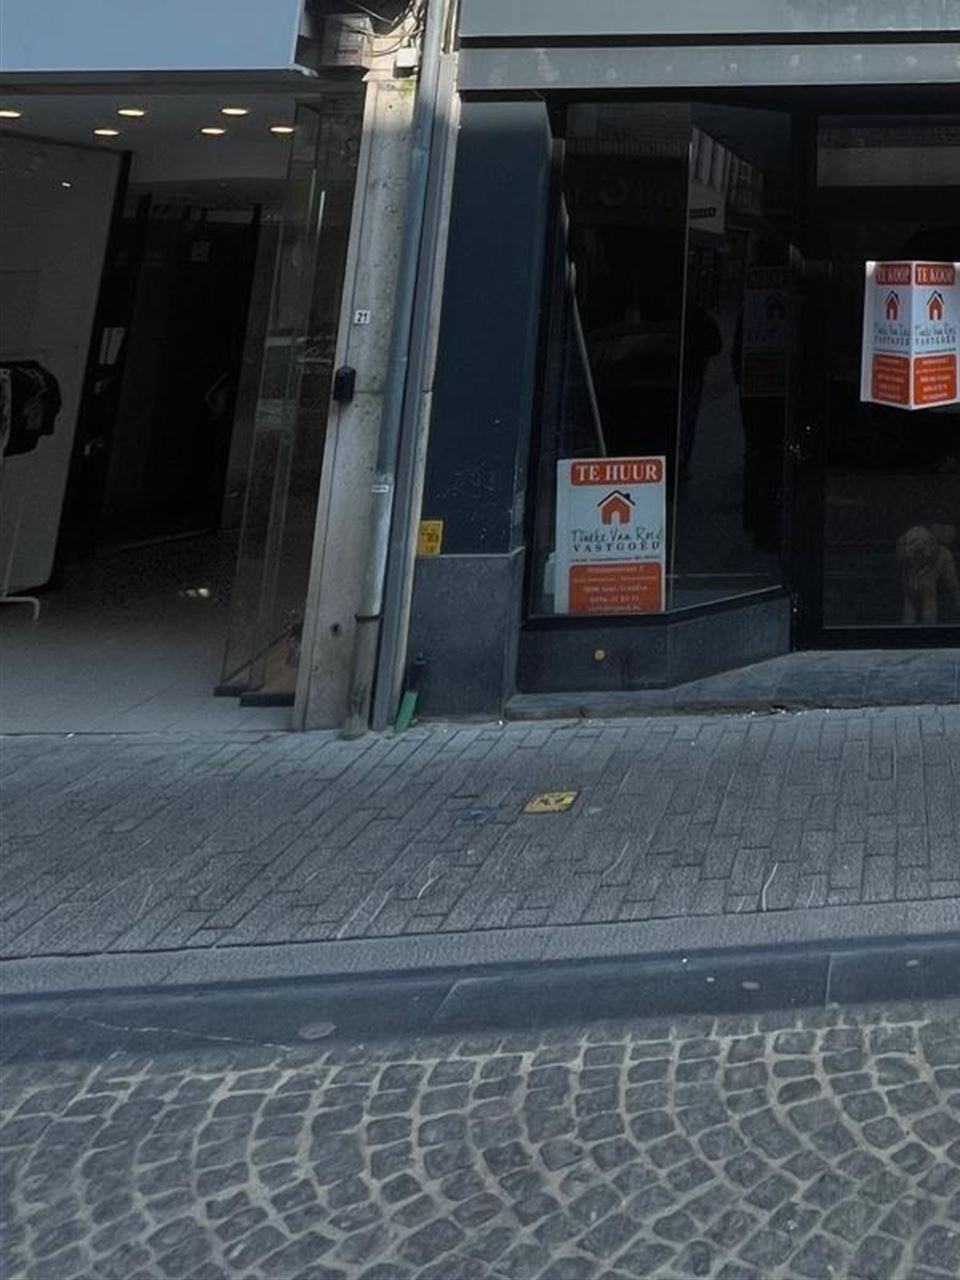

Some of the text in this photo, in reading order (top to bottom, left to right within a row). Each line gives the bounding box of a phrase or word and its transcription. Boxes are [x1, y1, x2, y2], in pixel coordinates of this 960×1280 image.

[356, 311, 369, 323] 21
[575, 463, 658, 482] TE HUUR
[573, 541, 660, 553] VASTGOED
